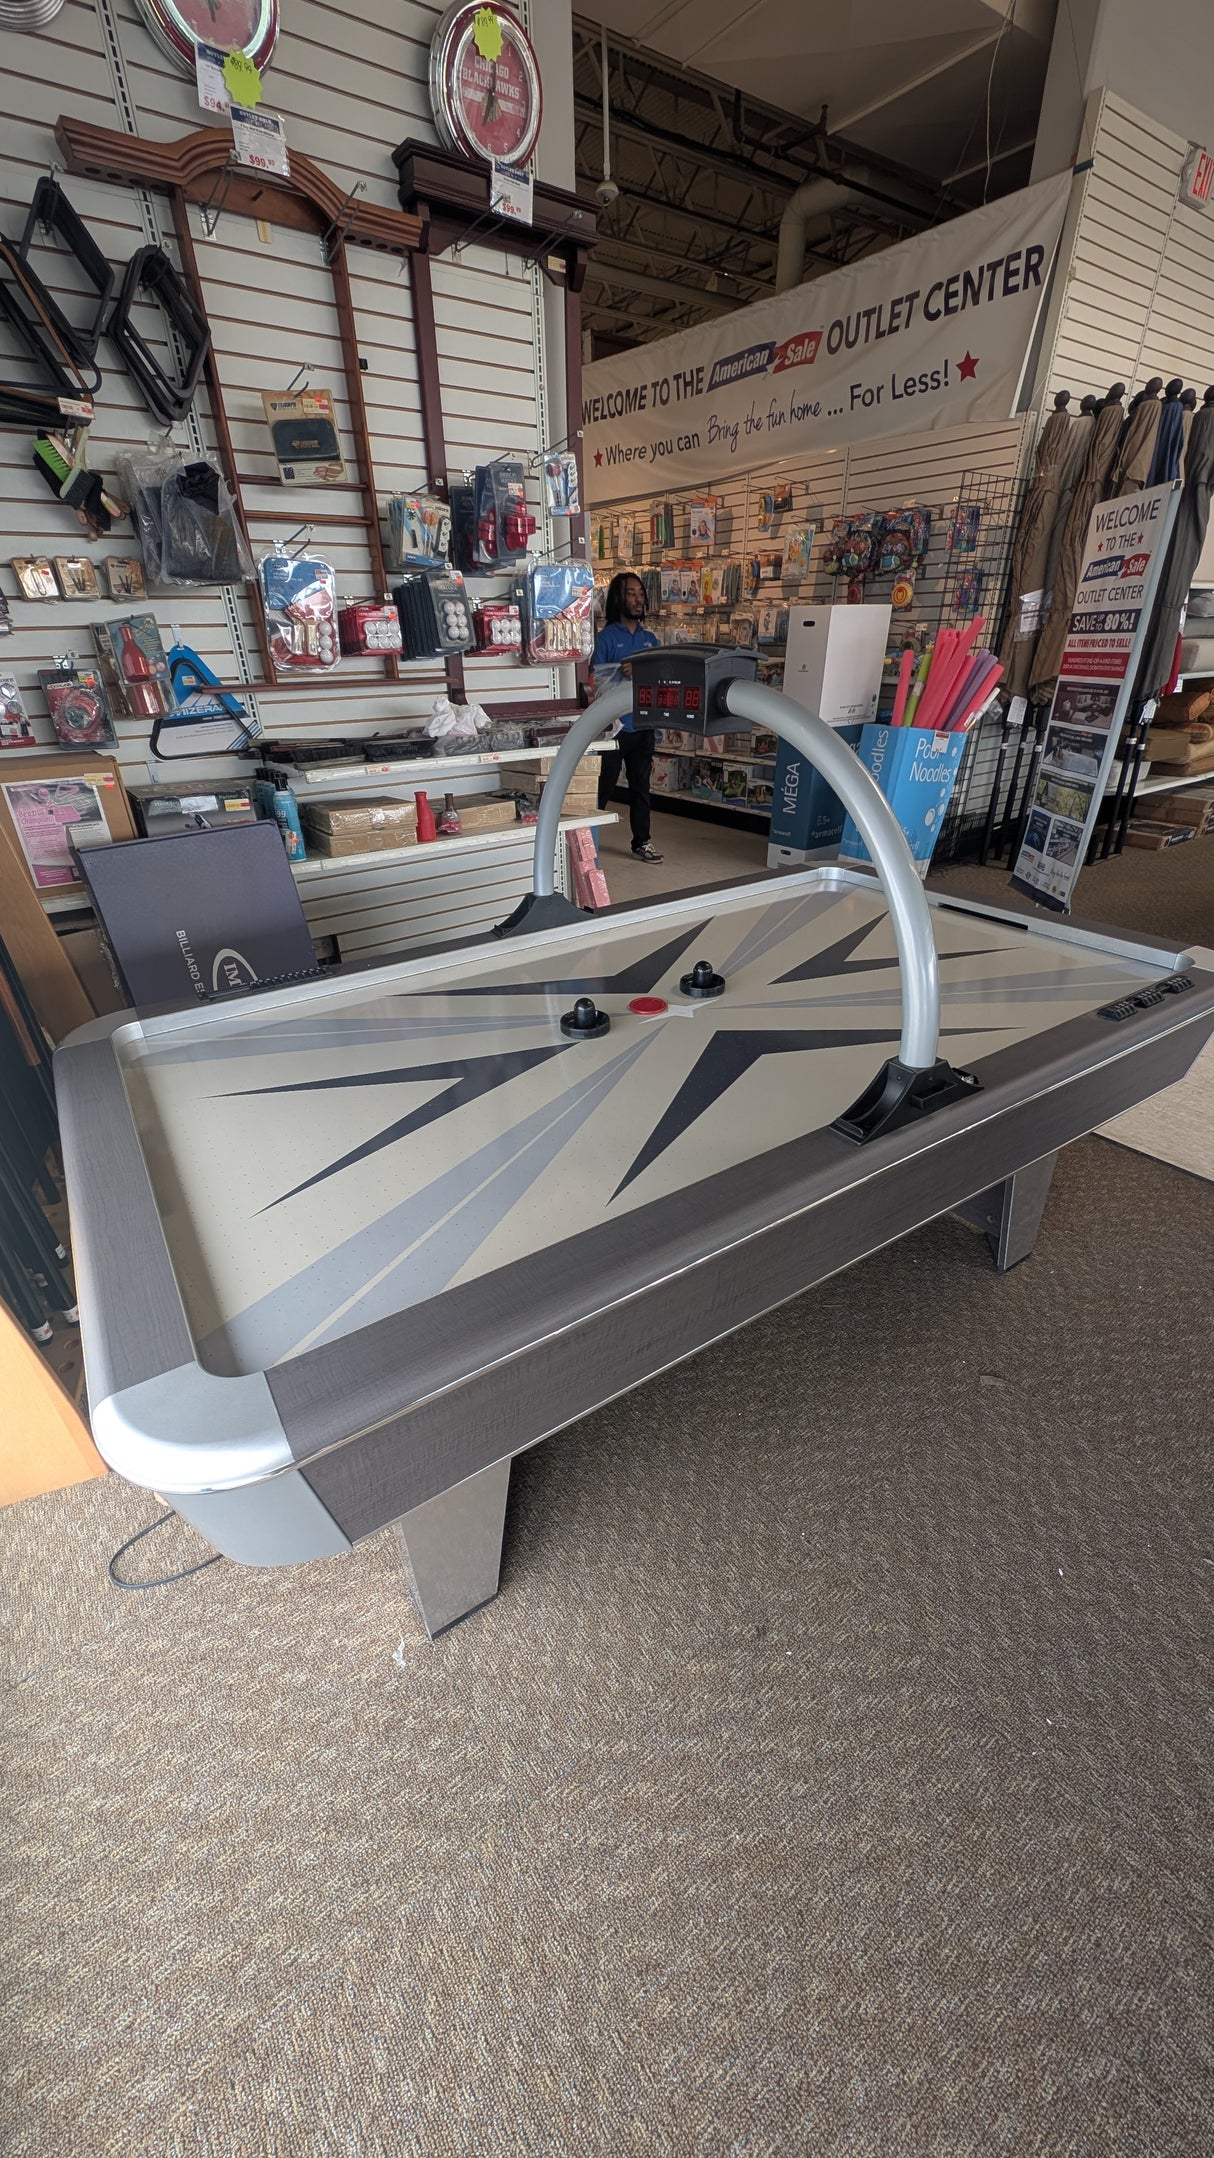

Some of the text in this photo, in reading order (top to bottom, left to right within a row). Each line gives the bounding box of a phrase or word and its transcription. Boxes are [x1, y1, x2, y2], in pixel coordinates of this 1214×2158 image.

[581, 243, 1045, 426] WELCOME TO THE American Sale OUTLET CENTER
[605, 443, 648, 467] Where
[649, 437, 674, 464] you
[676, 431, 701, 452] can
[706, 413, 740, 453] Bring
[743, 400, 764, 436] the
[765, 397, 788, 433] fun
[789, 388, 823, 427] home
[849, 383, 885, 411] For
[891, 358, 950, 401] Less!
[1095, 498, 1162, 533] WELCOME
[1105, 532, 1138, 552] TO THE
[1086, 556, 1146, 578] American Sale
[1076, 584, 1144, 605] OUTLET CENTER
[1072, 615, 1097, 631] SAVE
[1104, 612, 1136, 630] 80%!
[1068, 638, 1077, 648] ALL
[1109, 638, 1116, 648] TO
[1116, 637, 1131, 648] SELL!
[870, 729, 889, 782] oodles
[909, 761, 953, 783] Noodles
[782, 762, 801, 815] MÉGA
[175, 929, 201, 981] BILLIARD
